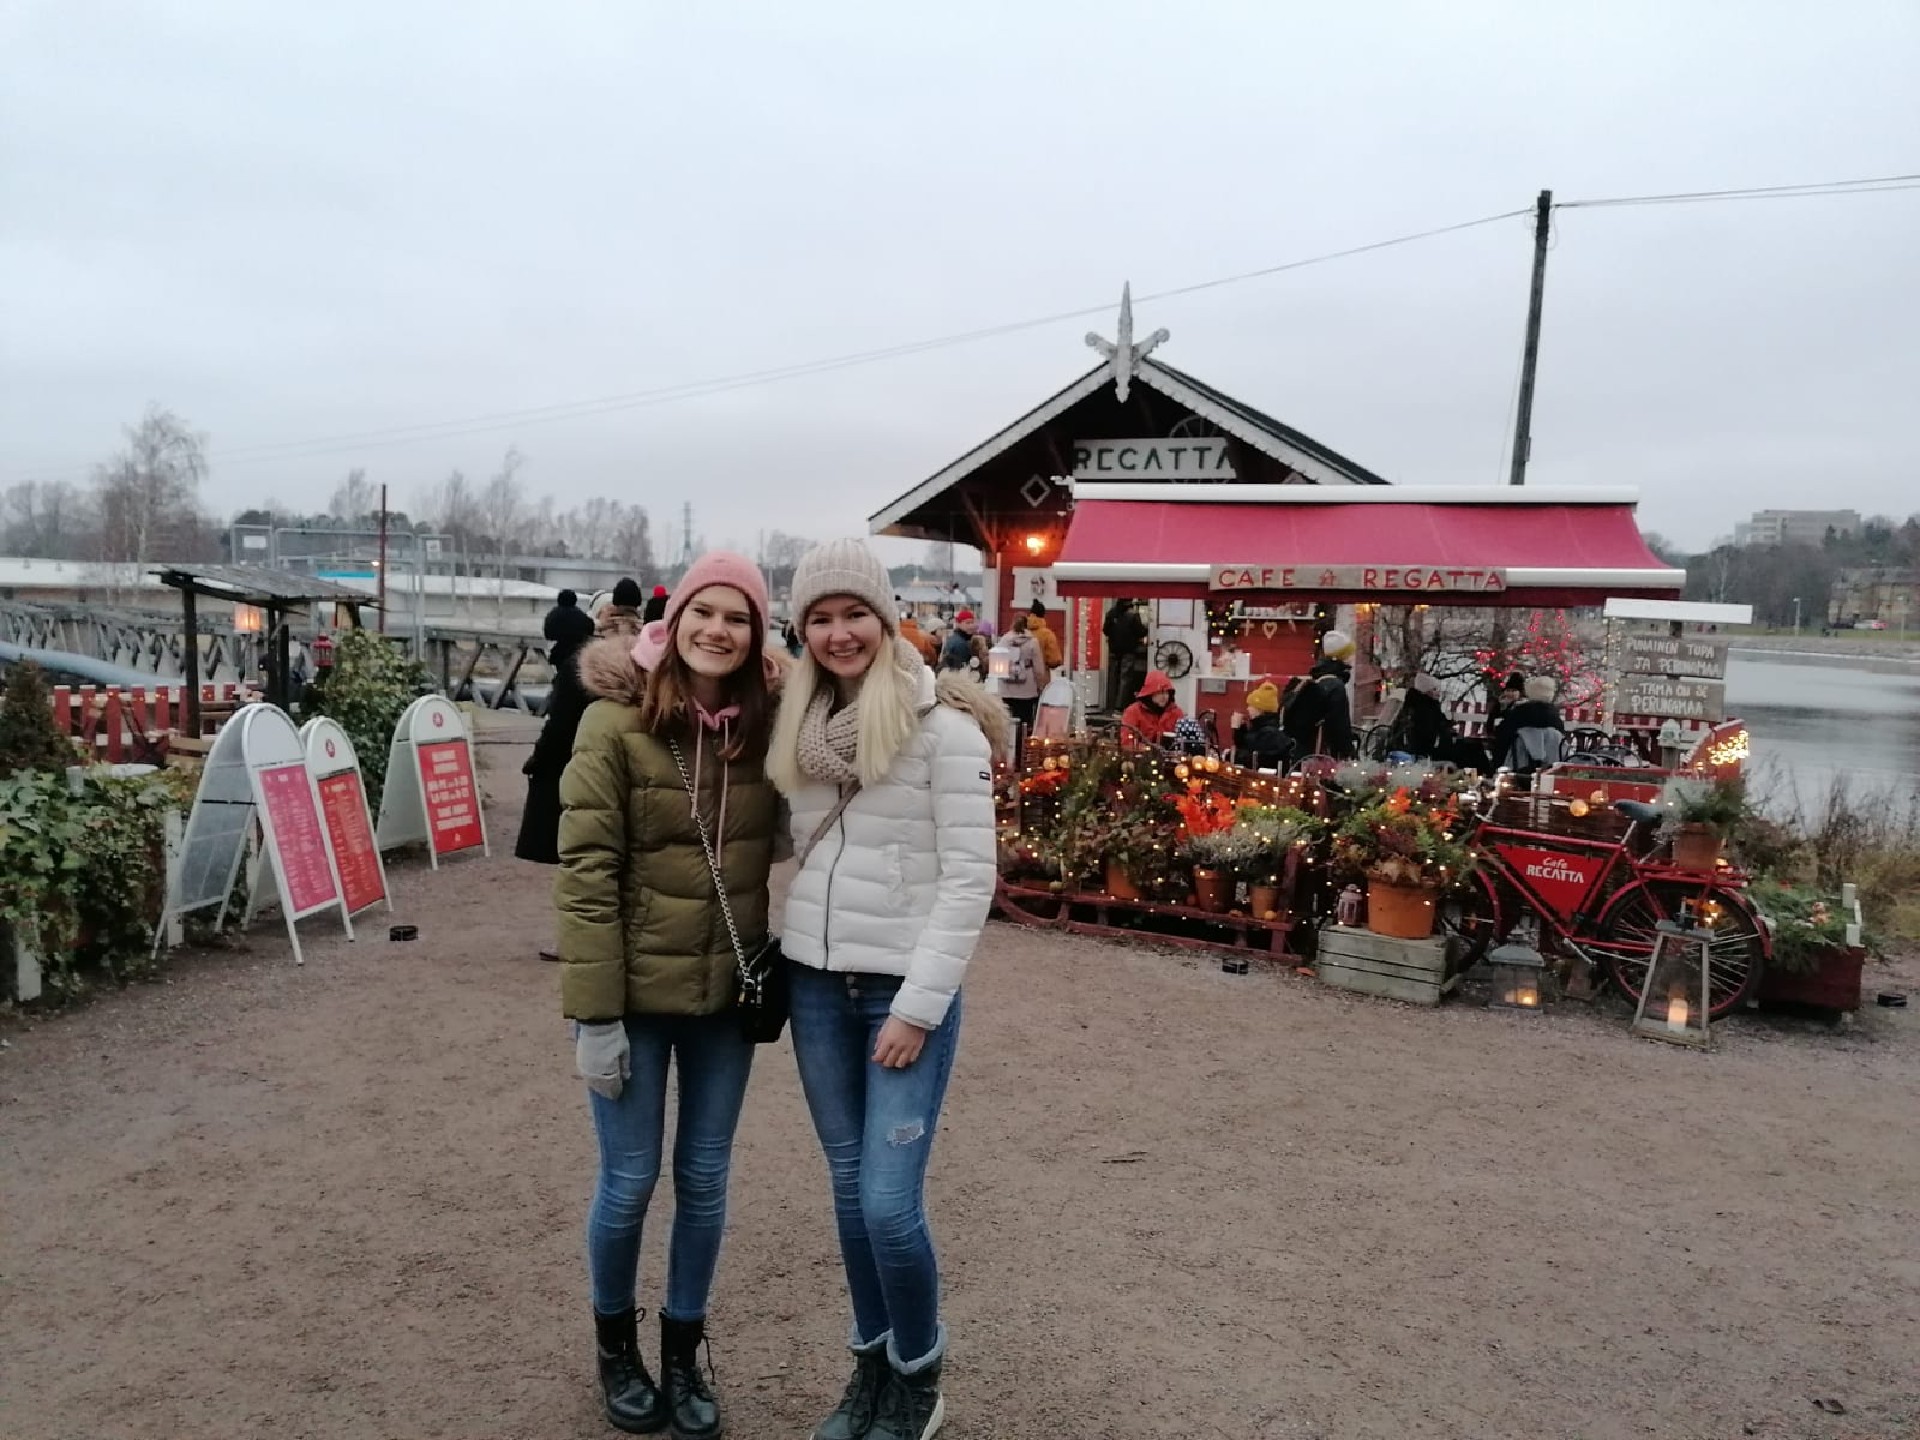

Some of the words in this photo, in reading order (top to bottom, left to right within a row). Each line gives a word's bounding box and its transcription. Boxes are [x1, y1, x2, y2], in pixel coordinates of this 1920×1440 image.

[1073, 447, 1236, 471] REGATTA
[1218, 569, 1296, 588] CAFE
[1363, 569, 1503, 589] REGATTA
[1686, 643, 1716, 660] TUPA
[1633, 657, 1652, 672] JA
